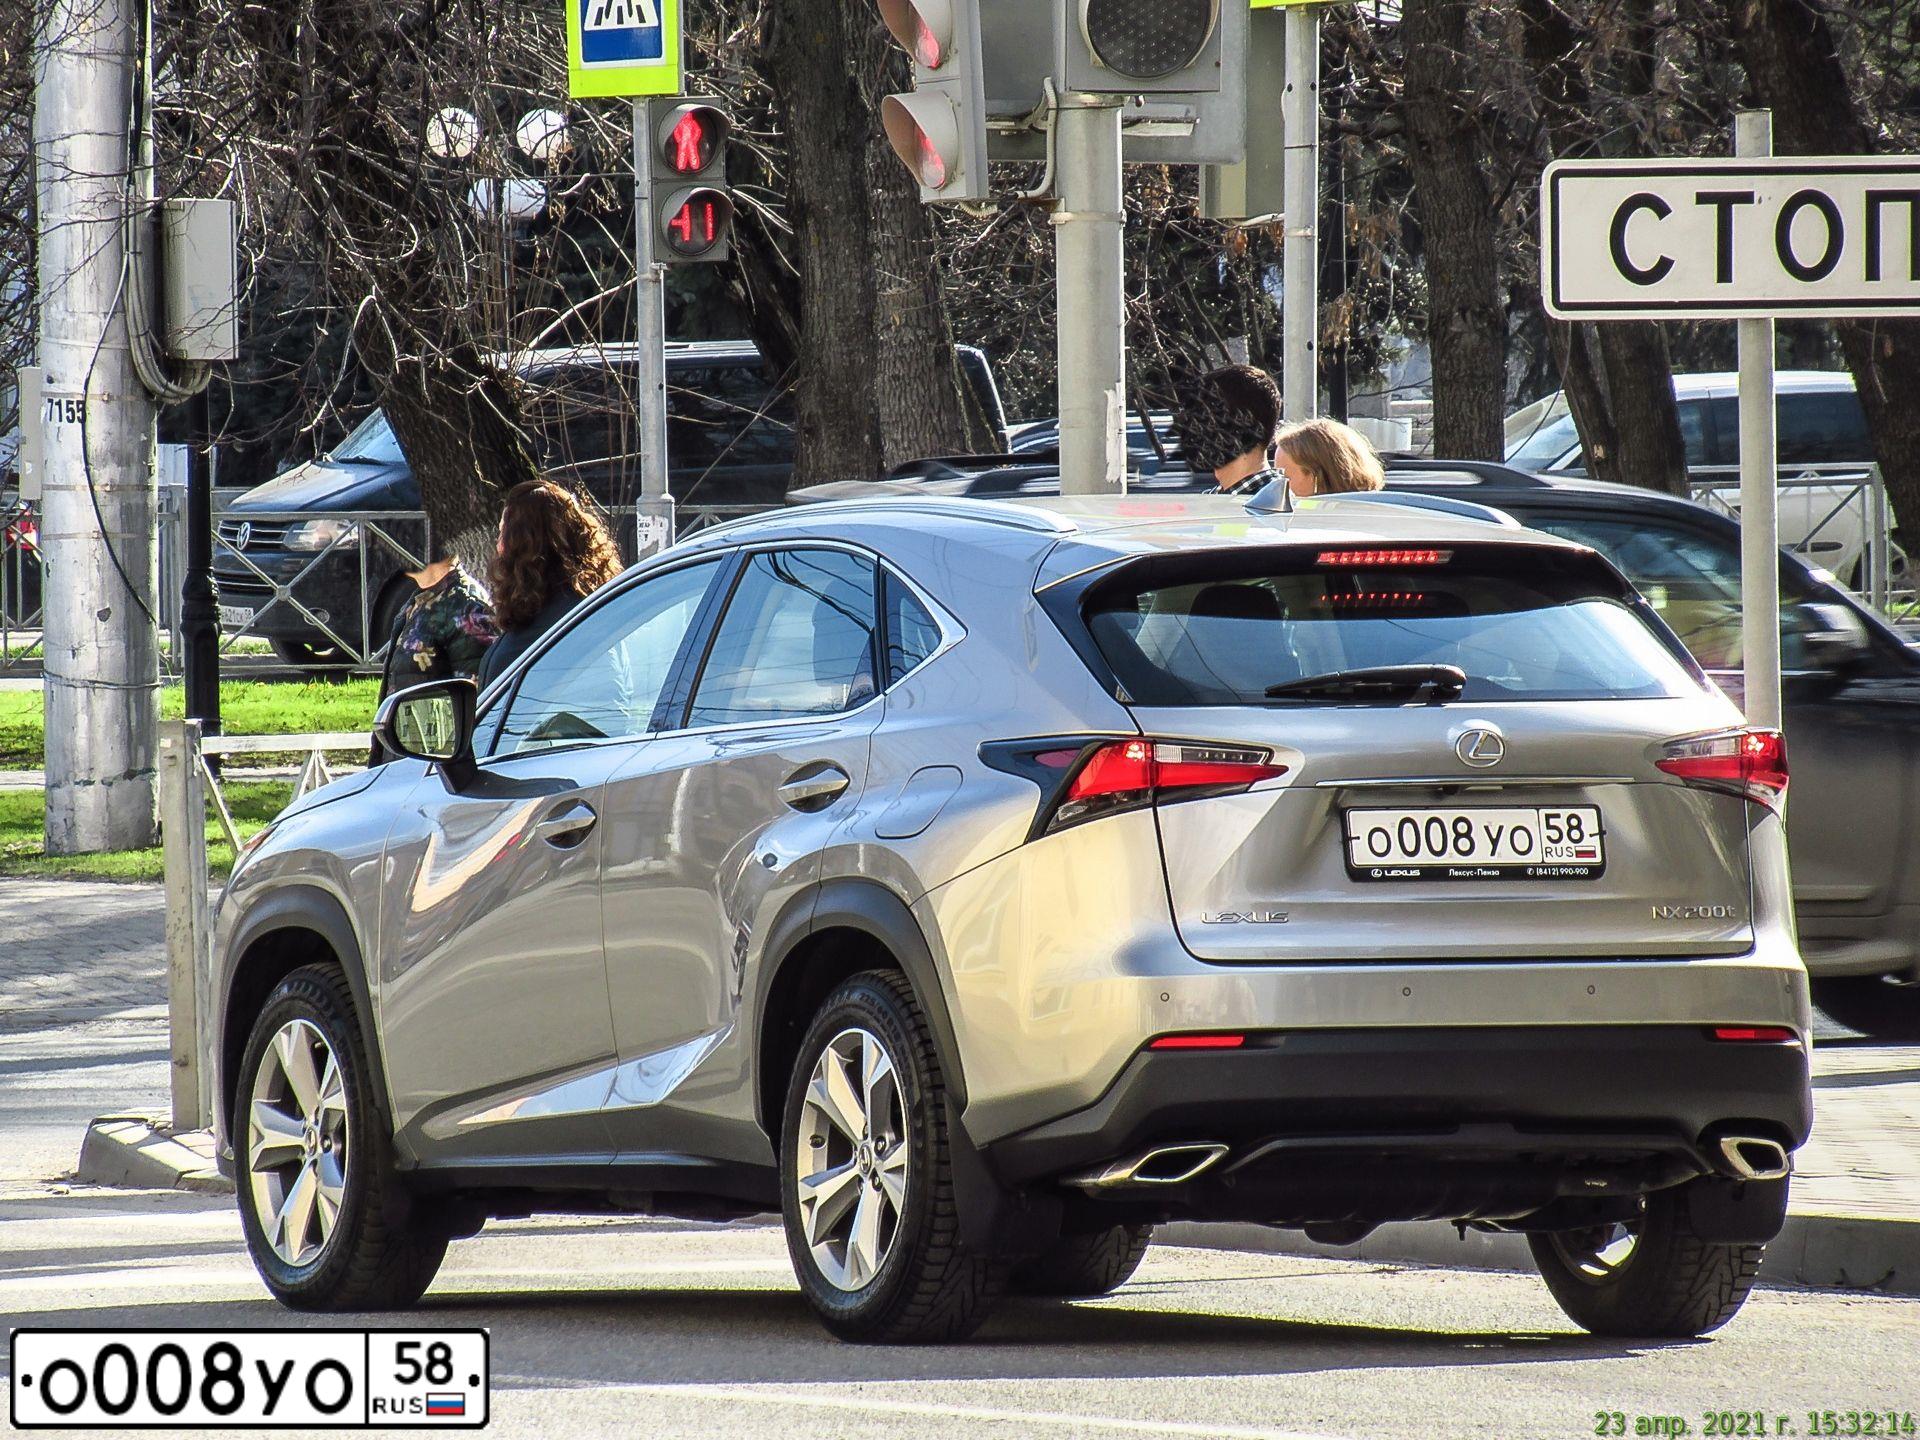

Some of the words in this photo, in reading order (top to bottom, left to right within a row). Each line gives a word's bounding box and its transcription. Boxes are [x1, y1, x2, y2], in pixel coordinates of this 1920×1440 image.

[1609, 189, 1920, 286] СТОП
[47, 398, 87, 424] 7155
[1545, 813, 1585, 845] 58
[1545, 846, 1574, 858] RUS
[1384, 869, 1421, 877] LEXUS
[1448, 868, 1500, 877] Лексус-Пенза
[1536, 867, 1559, 876] (8412)
[1560, 867, 1589, 876] 990-900
[1201, 912, 1289, 924] LEXUS
